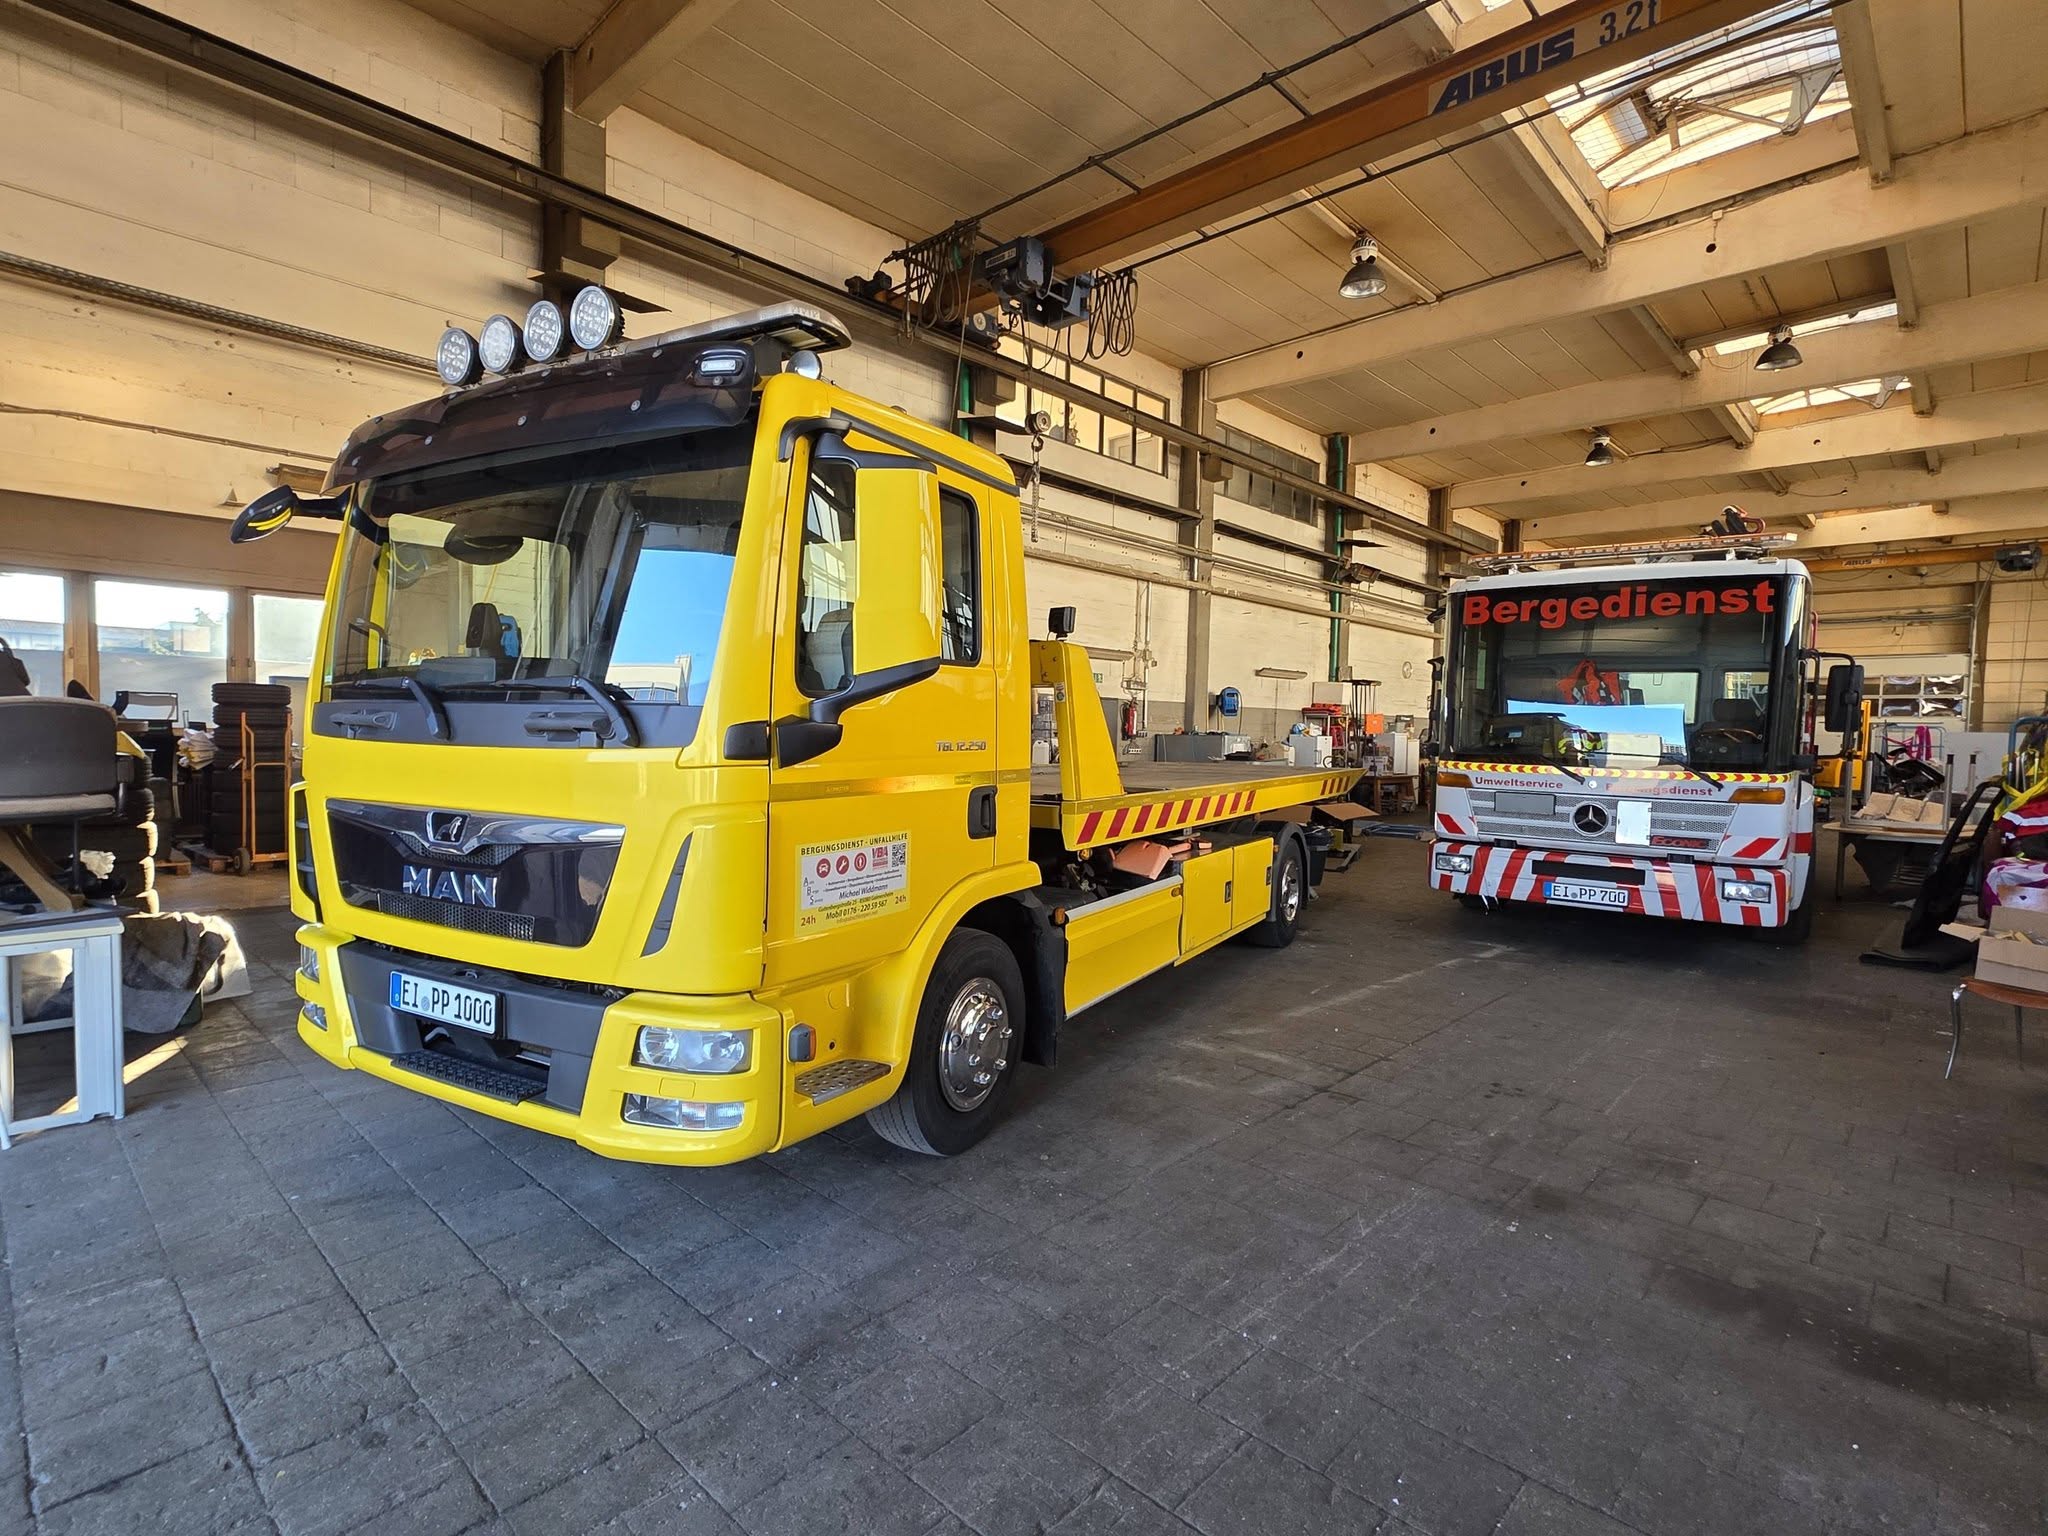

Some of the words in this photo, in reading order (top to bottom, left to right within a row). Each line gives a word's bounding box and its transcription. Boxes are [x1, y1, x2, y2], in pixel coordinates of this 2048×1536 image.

[1430, 27, 1575, 116] ABUS
[1462, 580, 1775, 629] Bergedienst
[956, 741, 986, 751] 12.250
[1475, 776, 1563, 789] Umweltservice
[1605, 782, 1713, 797] Bngsdienst
[801, 840, 863, 855] BERGUNGSDIENST
[870, 833, 908, 845] UNFALLHILFE
[403, 865, 498, 908] MAN
[839, 887, 861, 900] Michael
[1553, 885, 1569, 898] EI
[1579, 887, 1597, 901] PP
[1600, 889, 1626, 904] 700
[895, 894, 907, 905] 24h
[826, 909, 842, 920] Mobil
[842, 906, 857, 917] 0176
[860, 902, 870, 912] 220
[800, 914, 816, 927] 24h
[402, 979, 419, 1008] EI
[431, 986, 450, 1015] PP
[454, 993, 493, 1027] 1000
